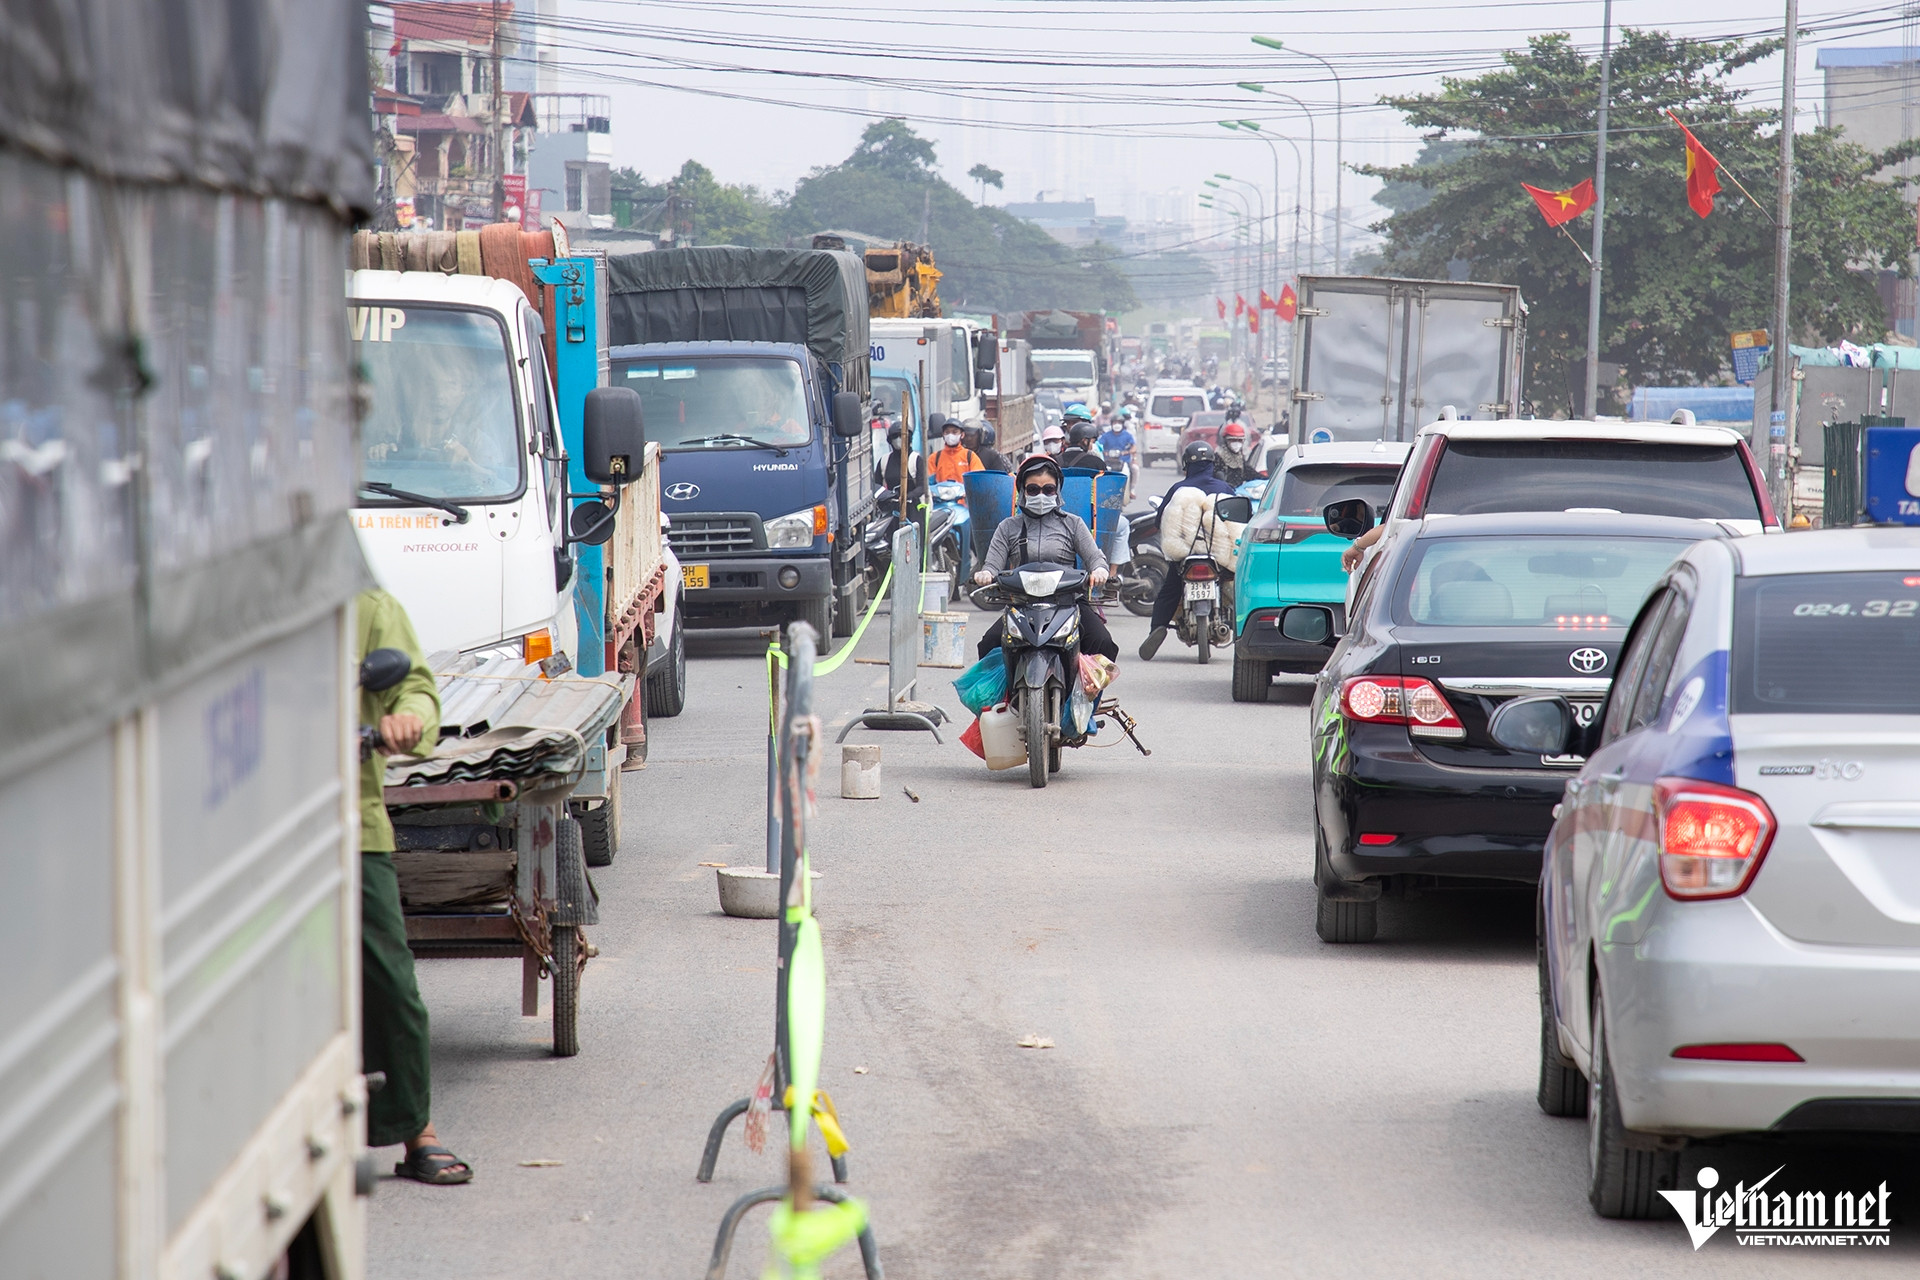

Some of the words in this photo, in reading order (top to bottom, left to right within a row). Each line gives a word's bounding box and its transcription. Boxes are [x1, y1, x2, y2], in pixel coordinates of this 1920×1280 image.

[347, 306, 406, 342] VIP
[753, 463, 799, 471] HYUNDAI
[358, 515, 374, 528] LÀ
[380, 514, 412, 528] TRÊN
[416, 512, 439, 528] HẾT
[403, 543, 479, 553] INTERCOOLER
[1190, 591, 1211, 599] 5697
